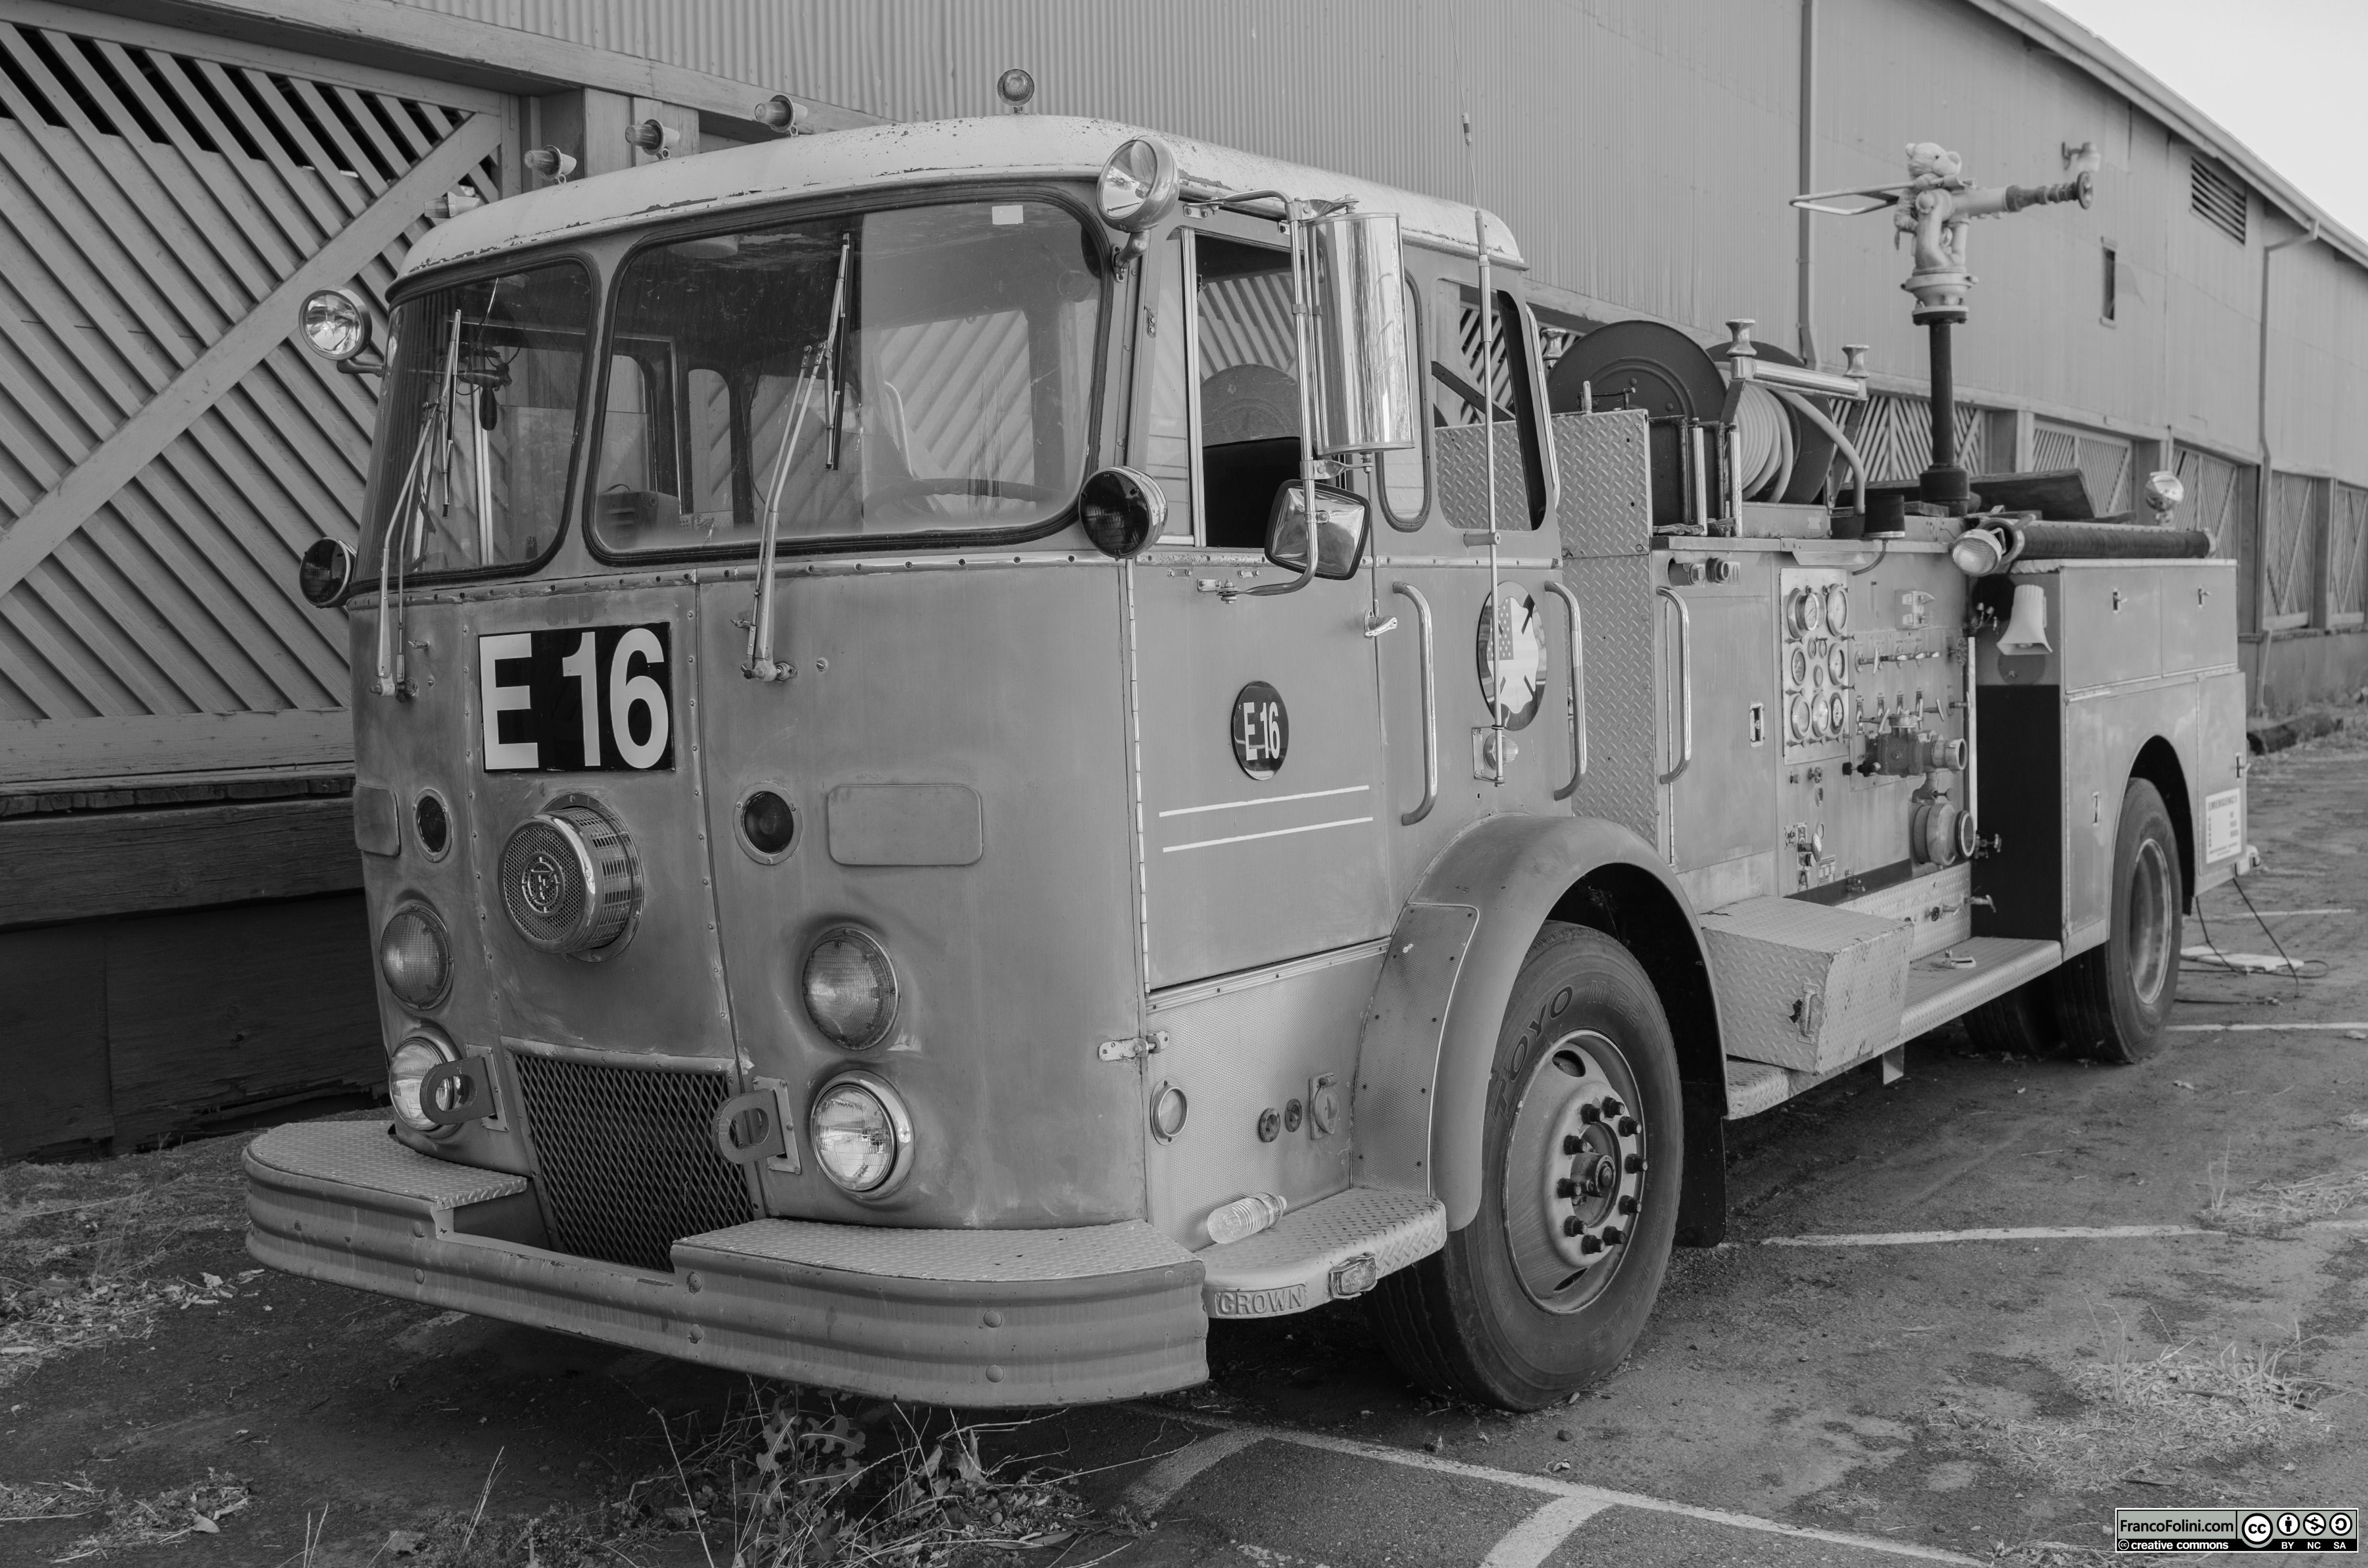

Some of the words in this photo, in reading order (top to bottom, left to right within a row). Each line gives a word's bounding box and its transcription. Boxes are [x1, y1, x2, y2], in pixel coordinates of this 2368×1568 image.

[562, 628, 668, 769] 16
[2208, 796, 2237, 811] EMERGENCY
[1492, 985, 1573, 1122] TOYO
[1587, 980, 1641, 1029] M122
[1219, 1285, 1305, 1314] CROWN
